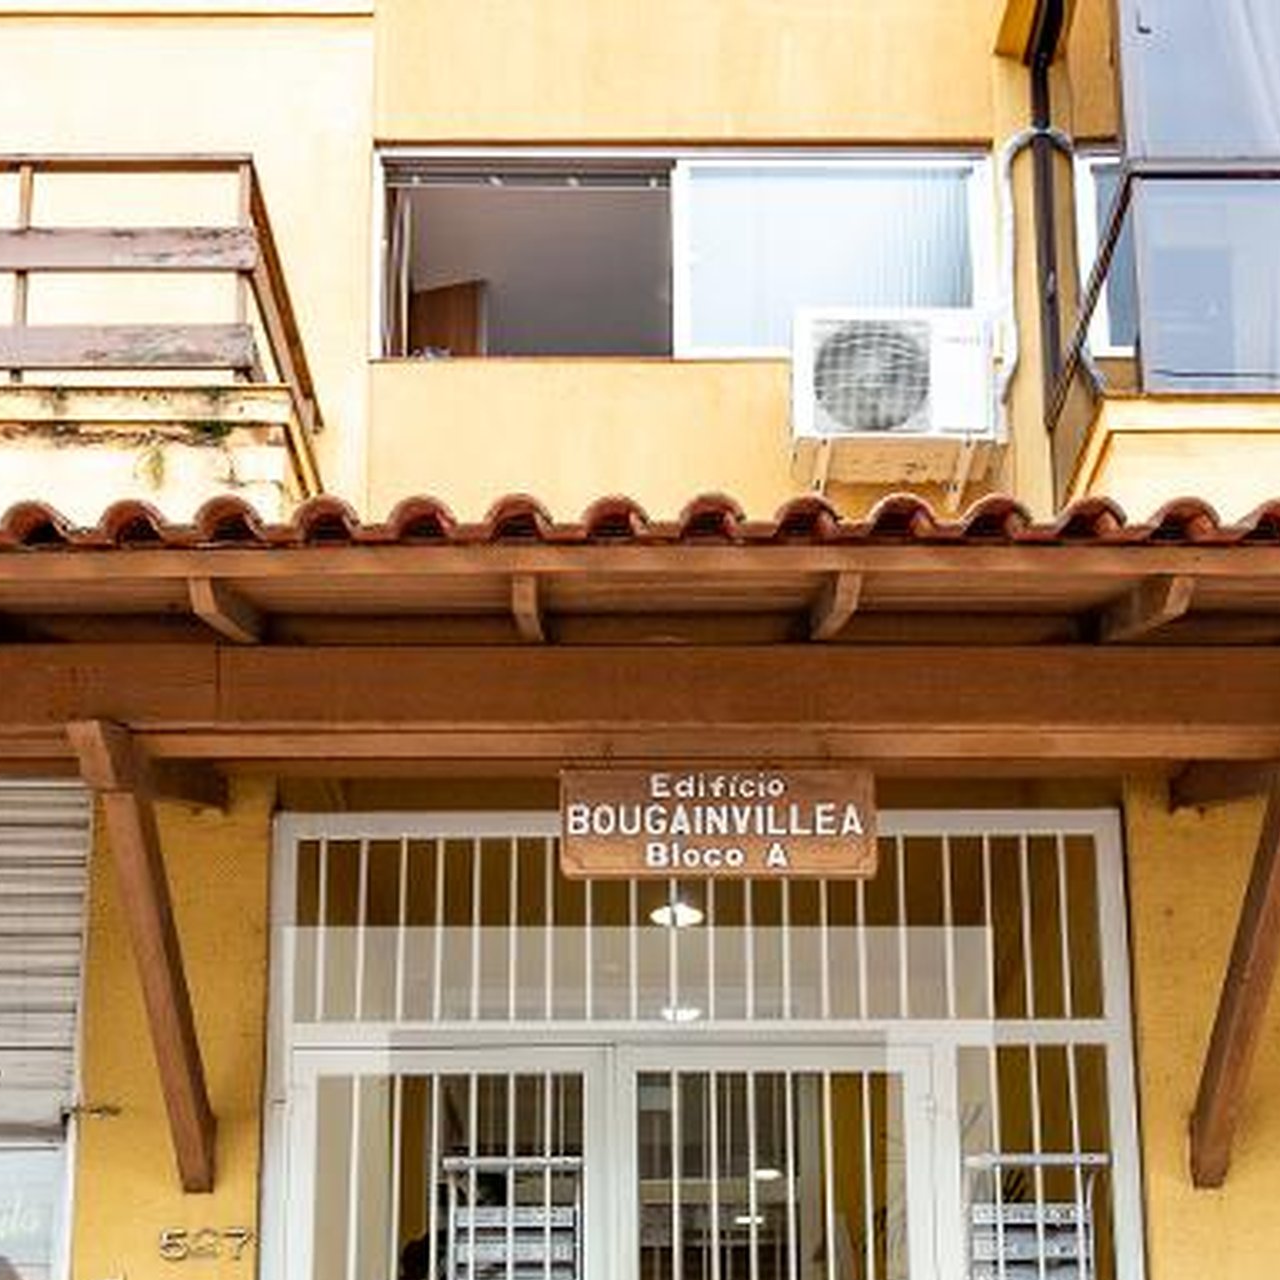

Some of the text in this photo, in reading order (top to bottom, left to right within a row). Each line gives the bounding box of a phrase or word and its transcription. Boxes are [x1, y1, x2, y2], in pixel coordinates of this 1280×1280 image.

[567, 803, 864, 836] BOUGAINVILLEA
[645, 843, 789, 867] Bloco A
